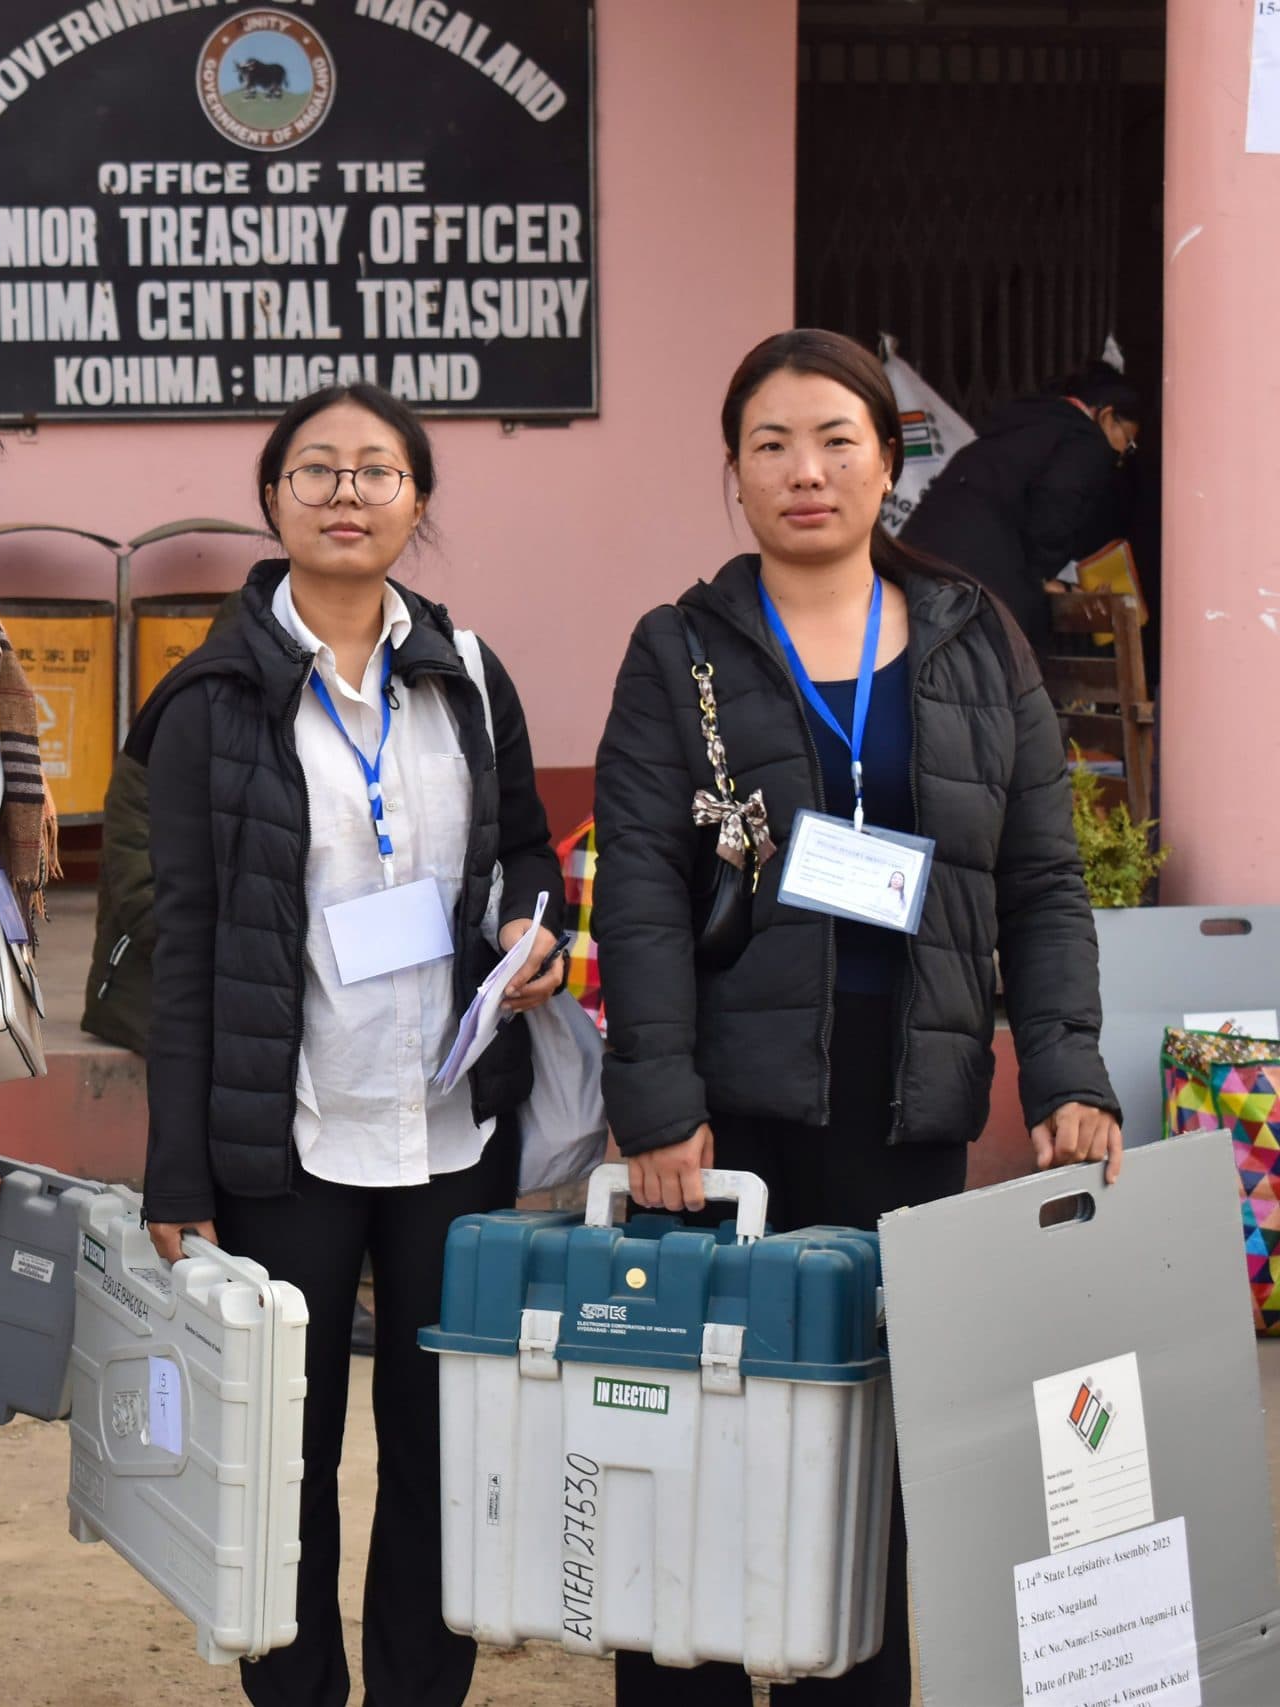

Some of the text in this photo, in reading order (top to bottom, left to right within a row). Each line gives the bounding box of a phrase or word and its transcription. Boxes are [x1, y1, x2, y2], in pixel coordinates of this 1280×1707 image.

[203, 57, 329, 144] GOVERNMENT OF NAGALAND
[99, 161, 424, 194] OFFICE OF THE
[120, 206, 347, 266] TREASURY
[370, 205, 581, 264] OFFICER
[138, 280, 340, 341] CENTRAL
[357, 279, 588, 340] TREASURY
[597, 1381, 666, 1410] IN ELECTION
[564, 1452, 600, 1557] 27530
[1017, 1580, 1025, 1591] 1.
[1043, 1570, 1065, 1584] State
[1067, 1556, 1111, 1577] Legislative
[1113, 1543, 1151, 1564] Assembly
[1152, 1536, 1171, 1551] 2023
[1019, 1616, 1028, 1627] 2.
[1058, 1594, 1098, 1616] Nagaland
[1022, 1652, 1030, 1663] 3.
[1033, 1646, 1047, 1660] AC
[1178, 1601, 1191, 1615] AC
[1024, 1652, 1134, 1696] 4. Date of Poll: 27-02-2023
[1122, 1682, 1159, 1702] Viswema
